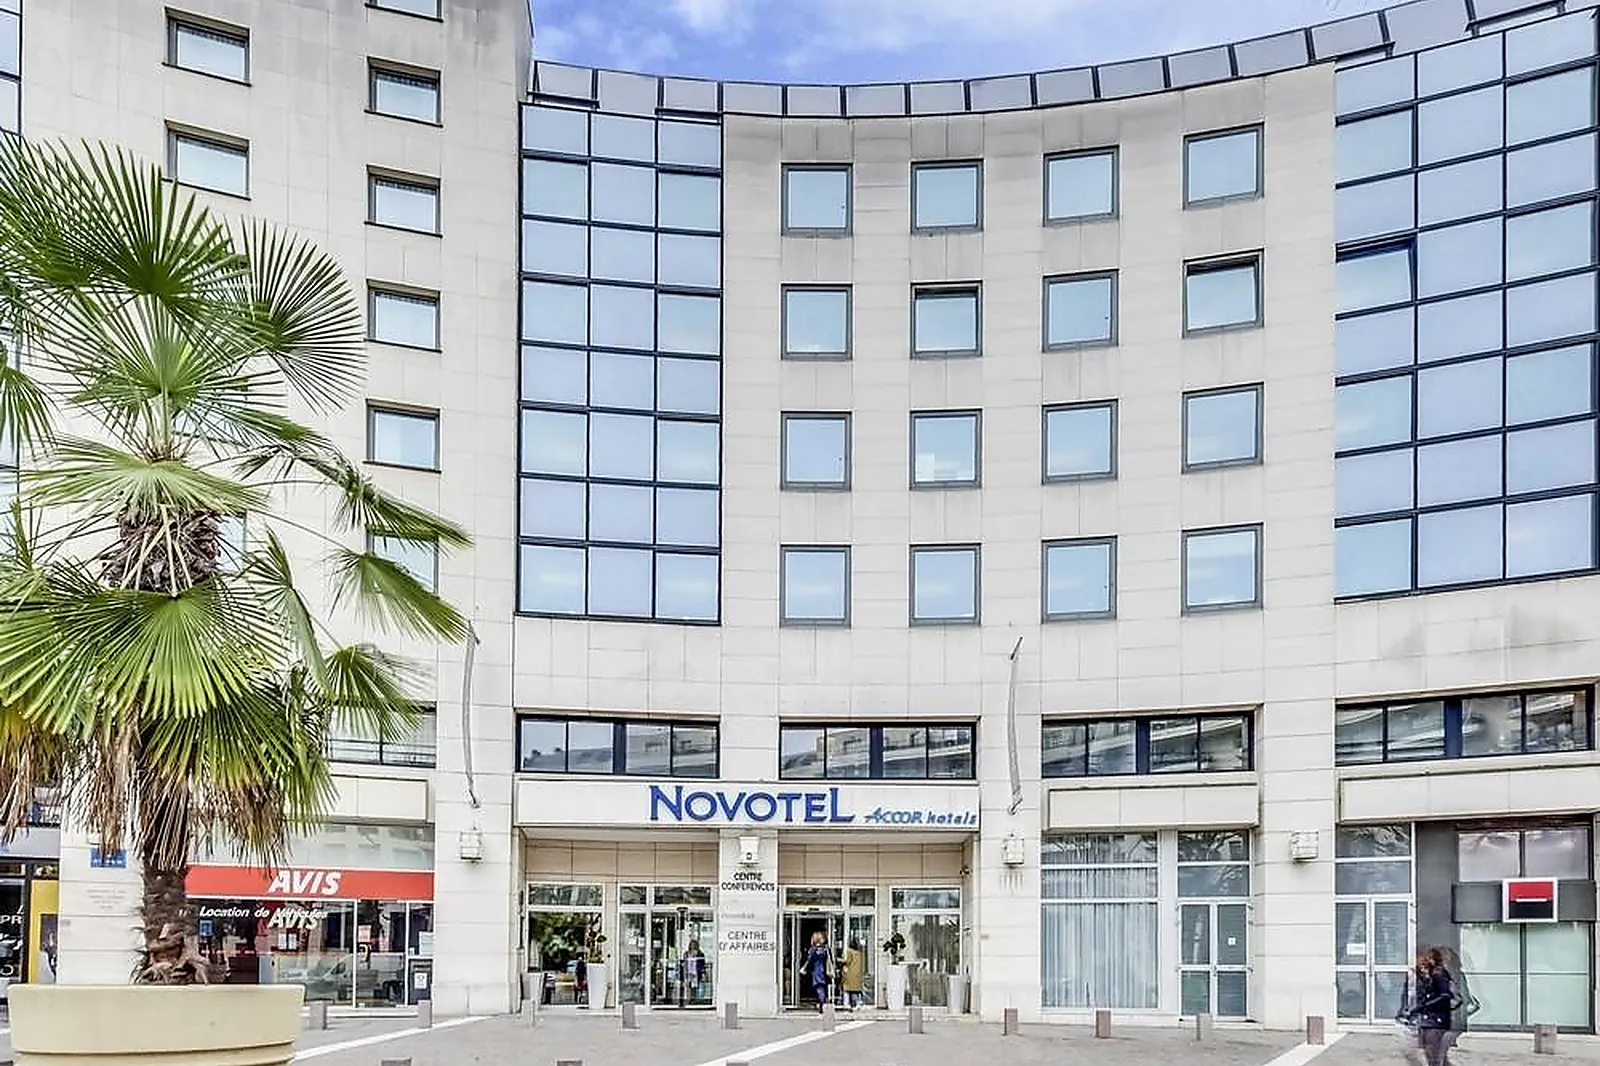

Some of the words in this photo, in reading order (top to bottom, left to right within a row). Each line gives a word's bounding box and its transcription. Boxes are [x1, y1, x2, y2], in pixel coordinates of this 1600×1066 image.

[650, 785, 854, 823] NOVOTEL
[926, 811, 977, 825] hotels
[267, 869, 342, 896] AVIS
[733, 871, 763, 881] CENTRE
[199, 905, 250, 918] Location
[254, 907, 270, 918] de
[727, 931, 767, 940] CENTRE
[719, 941, 775, 952] D'AFFAIRES
